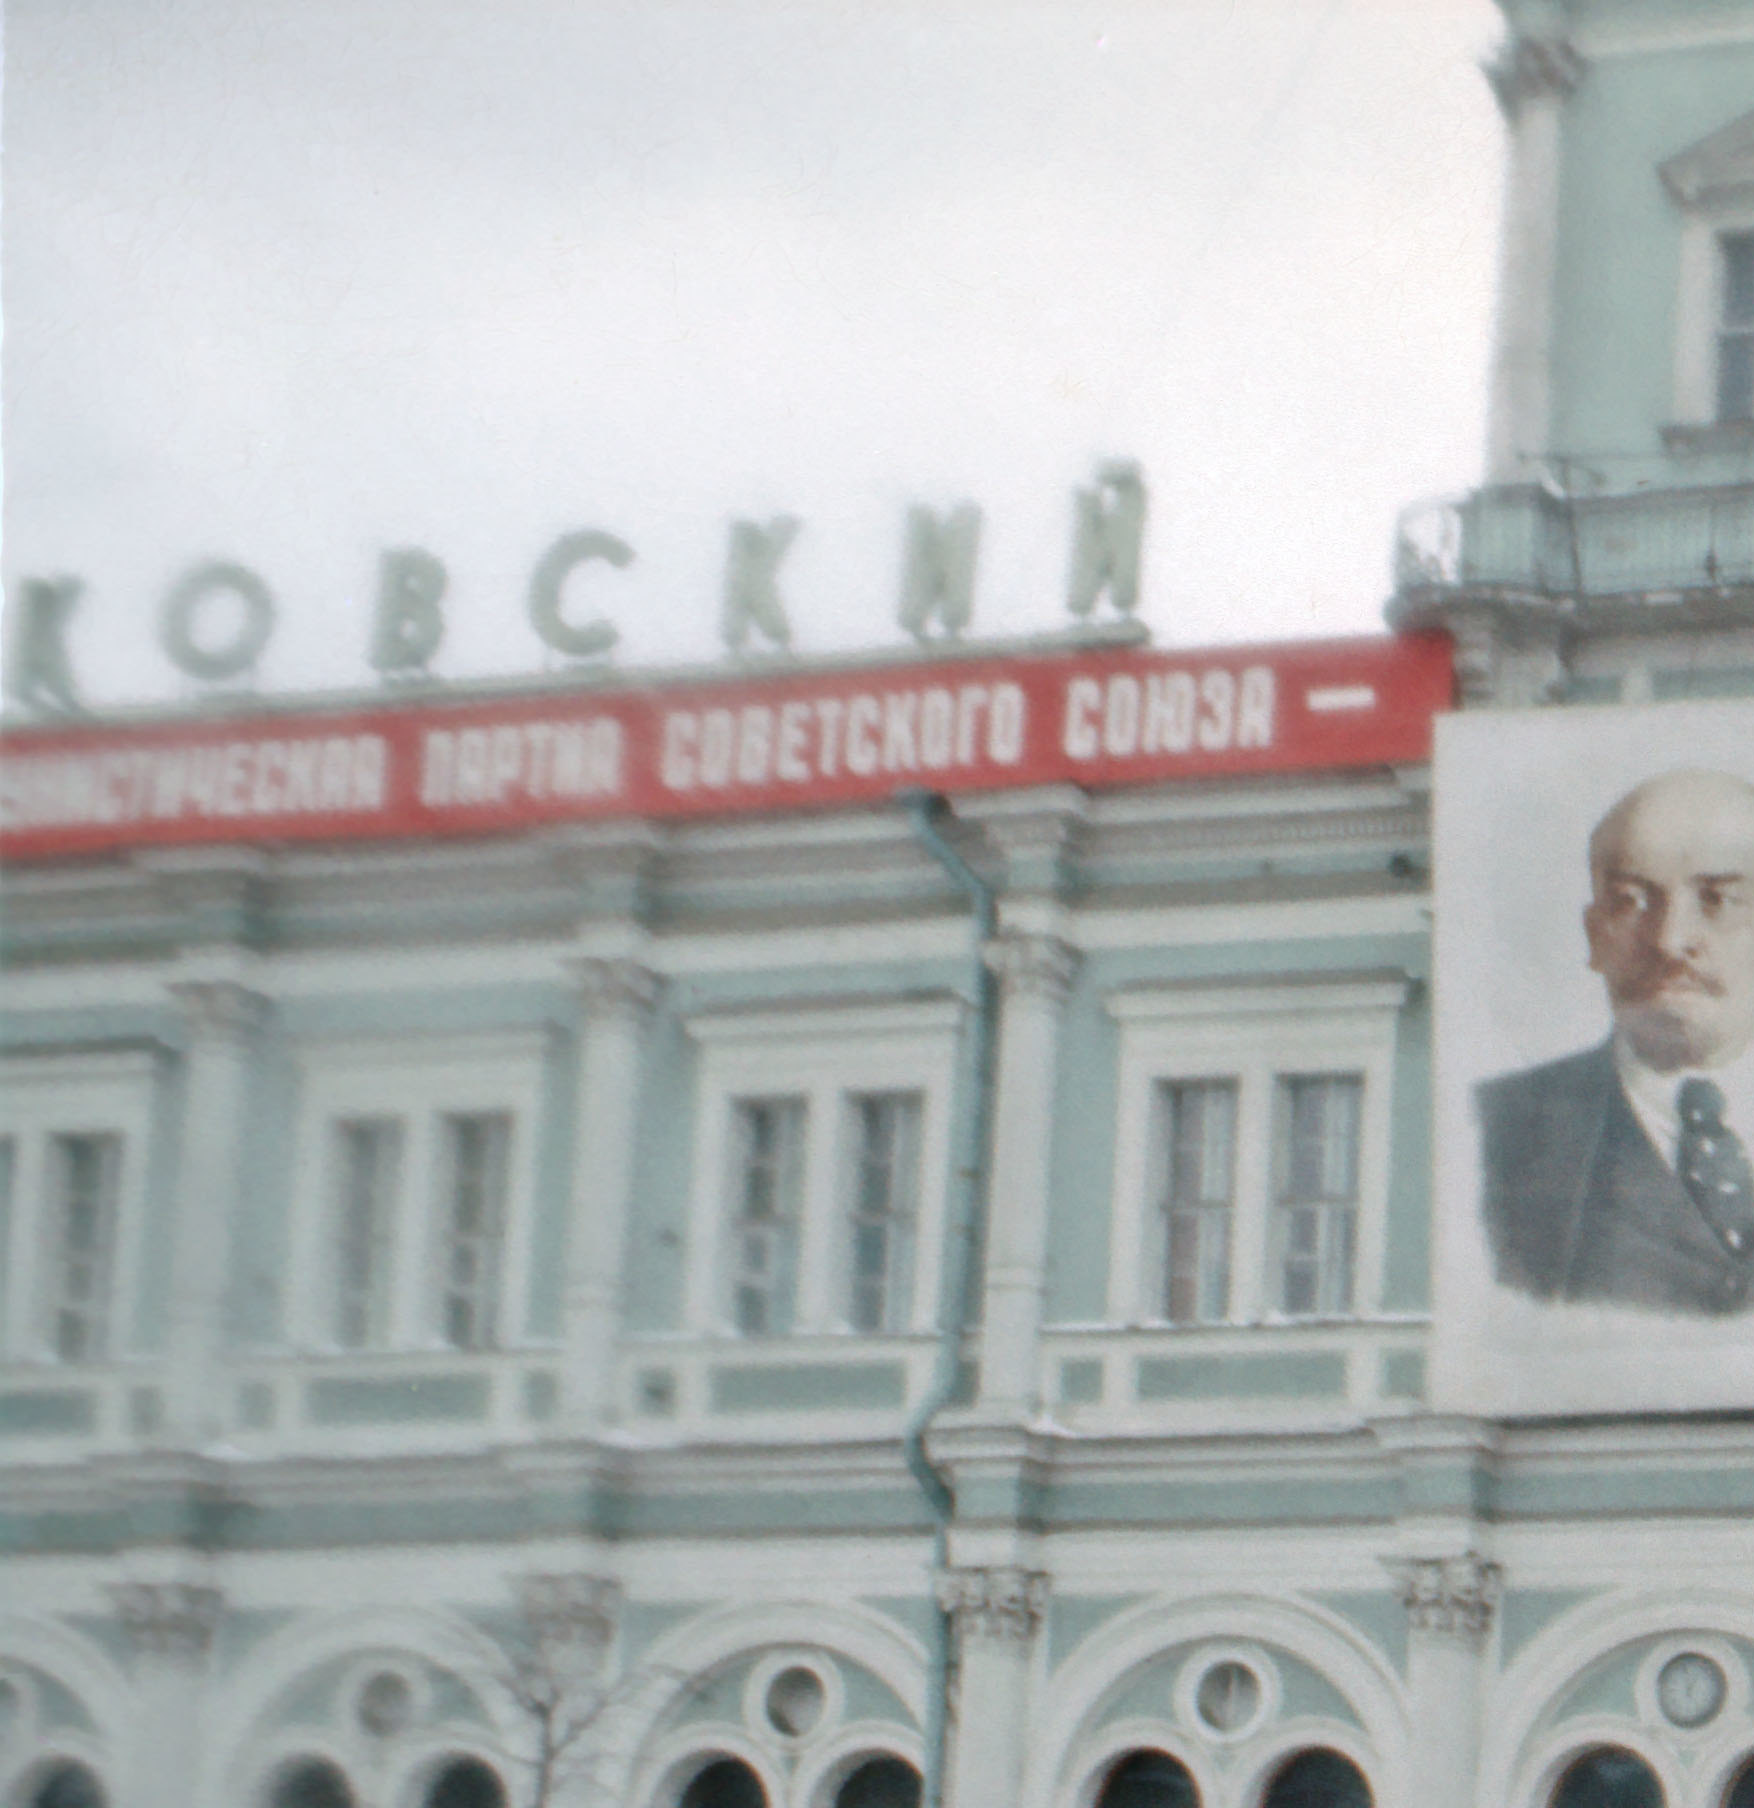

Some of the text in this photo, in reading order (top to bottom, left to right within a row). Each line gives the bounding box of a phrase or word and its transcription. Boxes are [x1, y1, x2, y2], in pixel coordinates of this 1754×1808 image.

[8, 455, 1147, 716] КОВСКИЙ
[420, 715, 627, 810] ПАРТИЯ
[661, 681, 1024, 792] СОВЕТСКОГО
[1063, 666, 1276, 762] СОЮЗА
